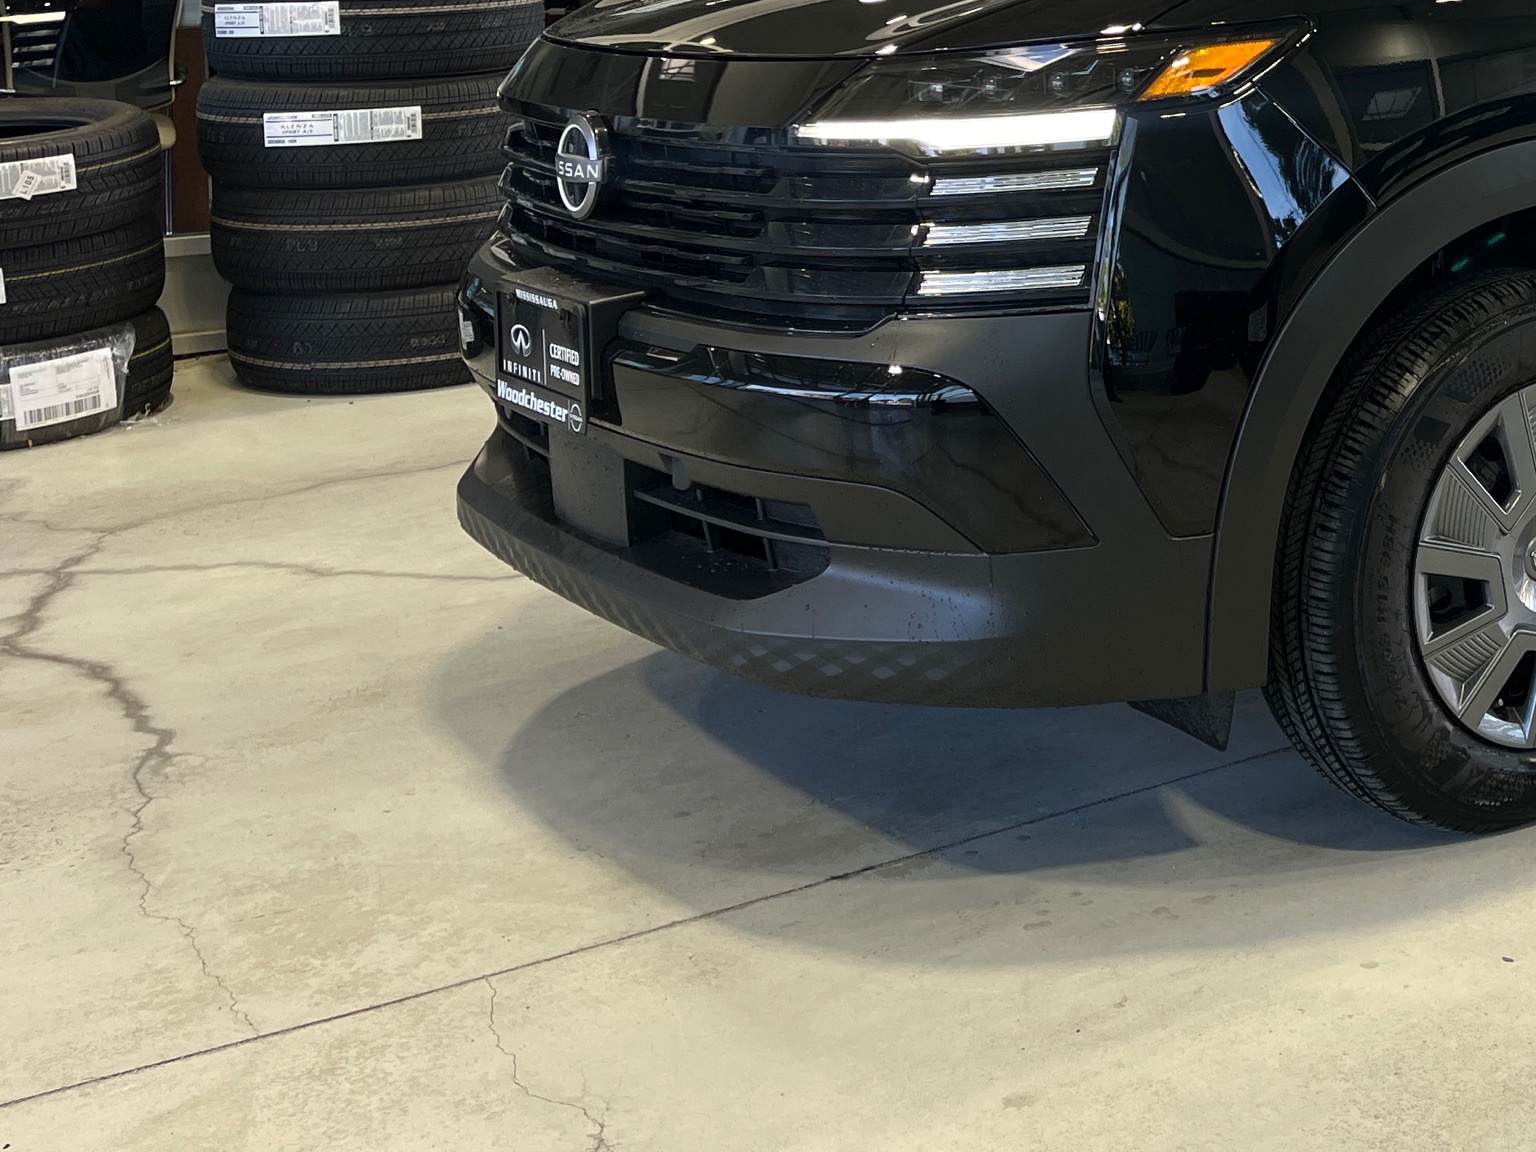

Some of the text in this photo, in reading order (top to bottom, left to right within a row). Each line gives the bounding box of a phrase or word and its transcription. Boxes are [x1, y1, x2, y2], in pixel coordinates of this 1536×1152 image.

[20, 175, 35, 194] L105
[516, 289, 558, 309] MISSISSAUGA
[550, 343, 580, 366] CERTIFIED
[503, 359, 541, 383] INFINITI
[550, 365, 580, 386] PRE-OWNED
[497, 380, 568, 422] Woodchester
